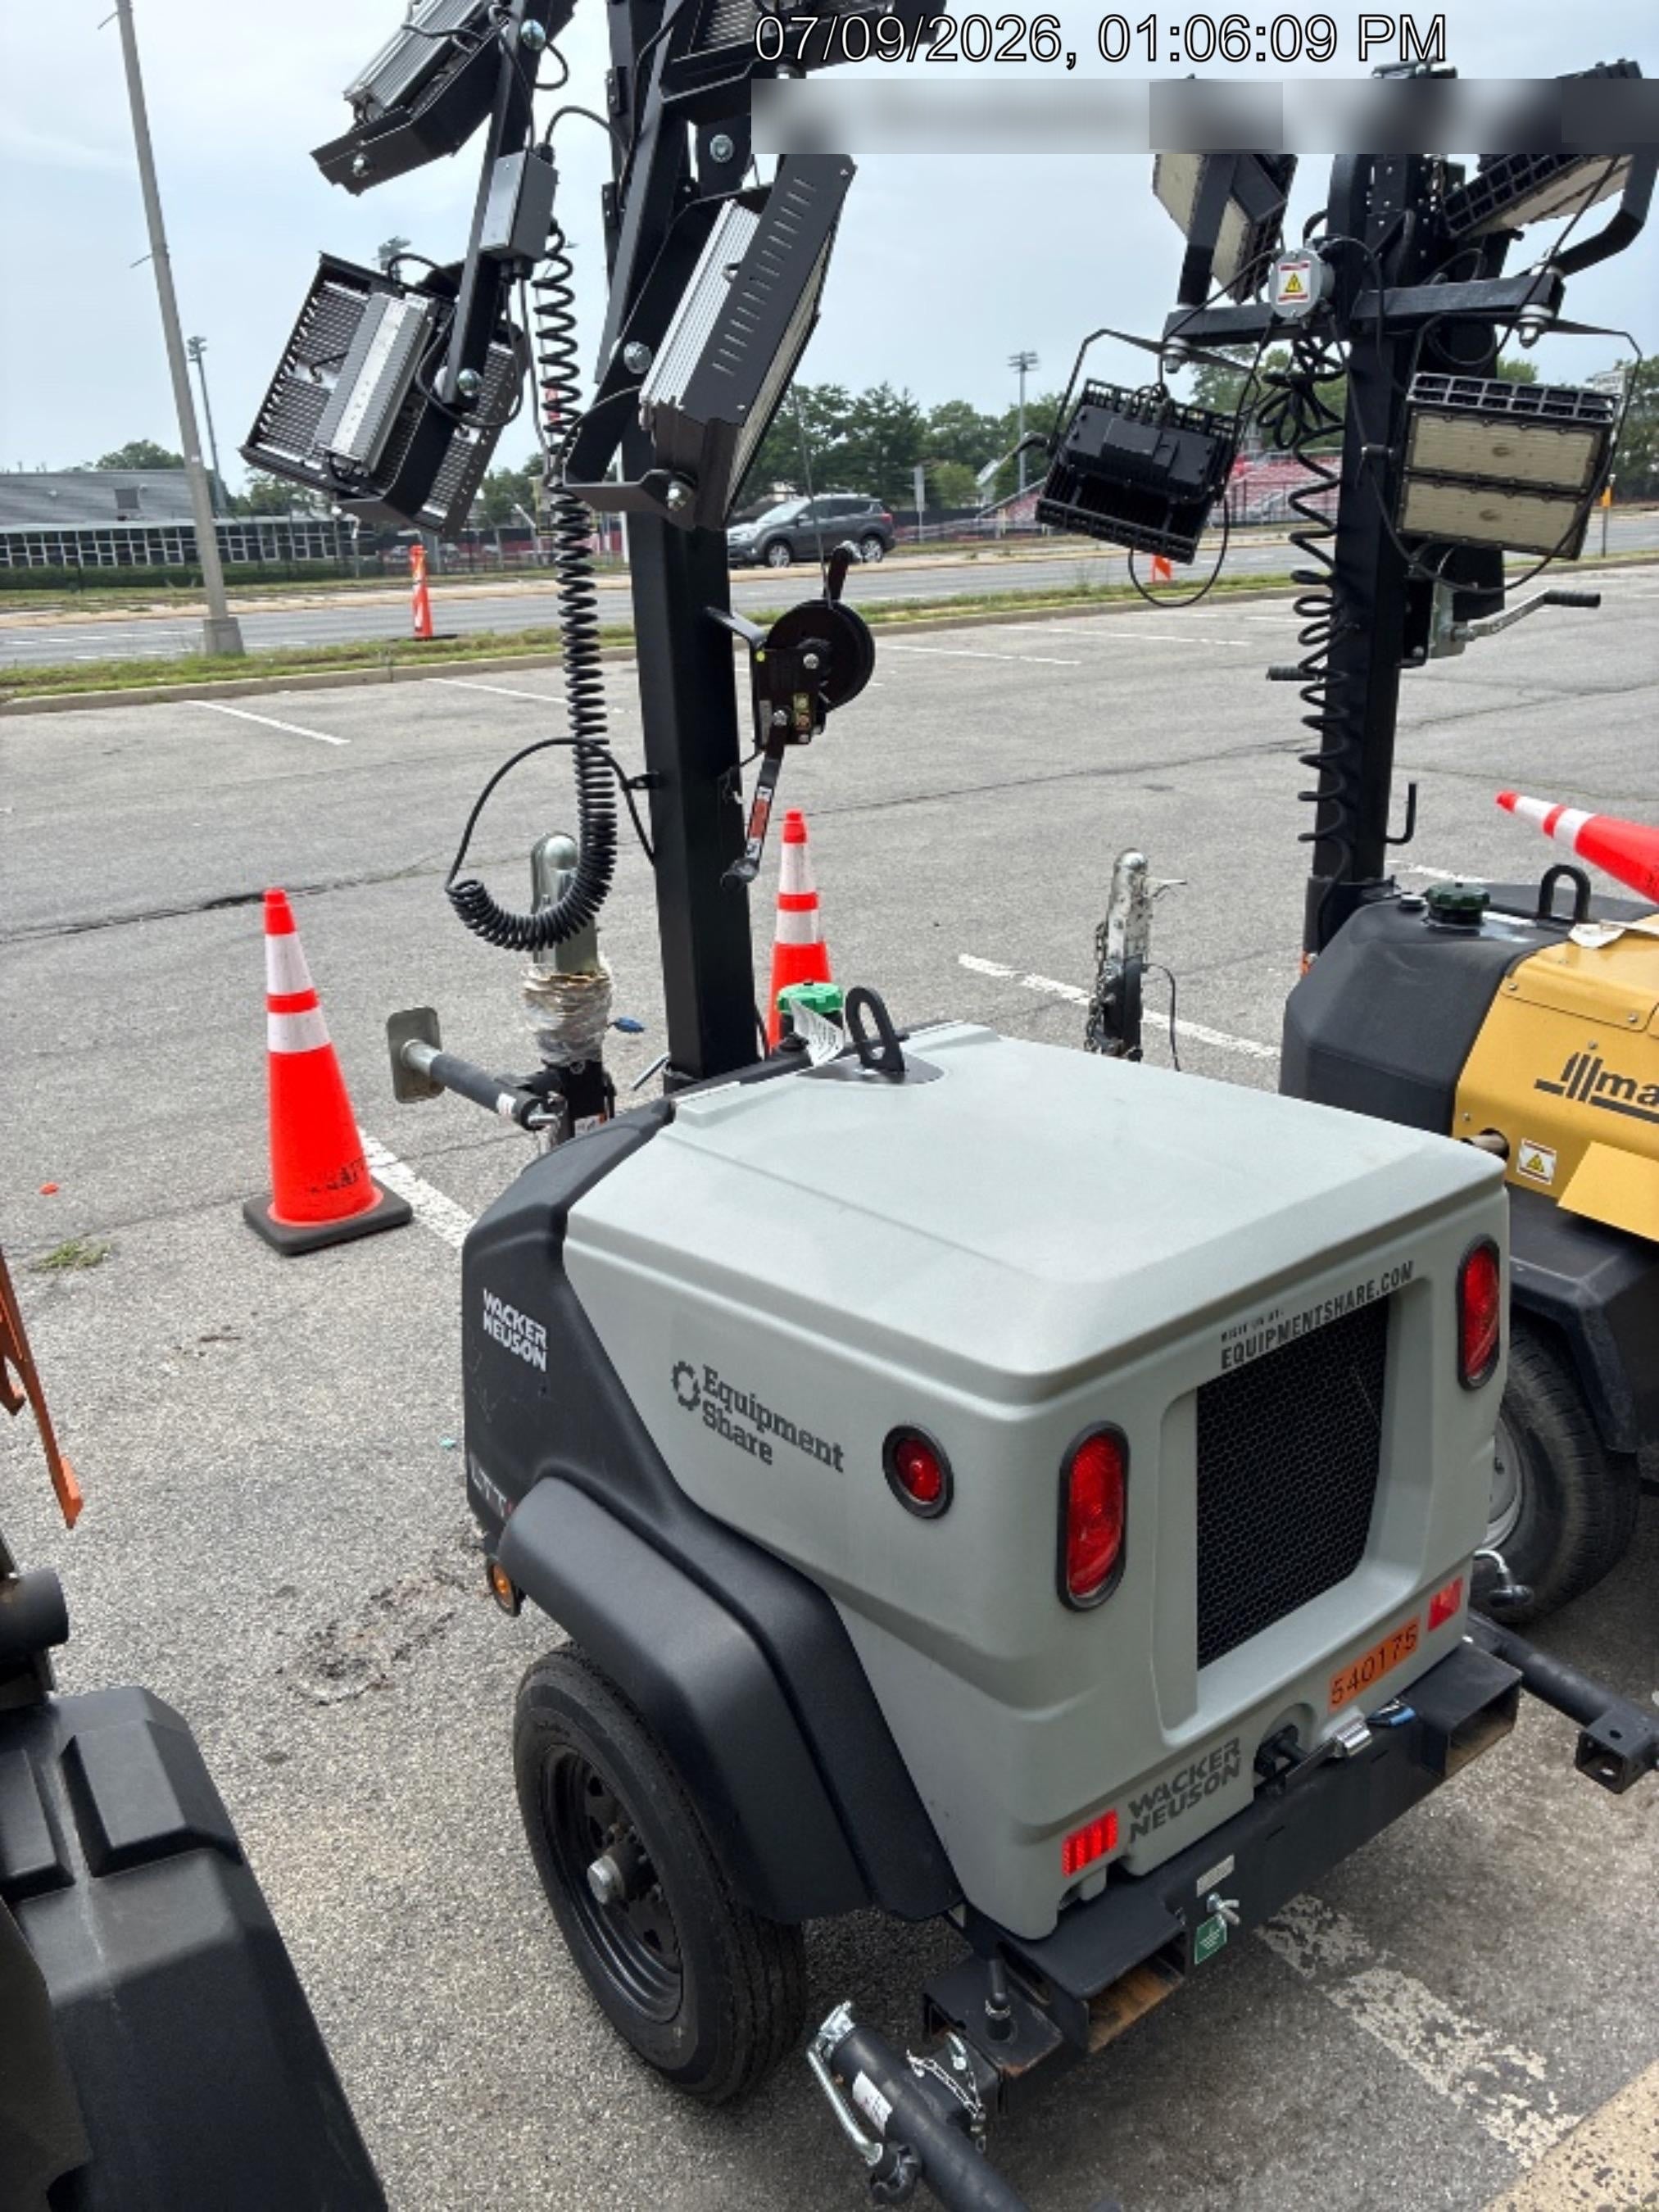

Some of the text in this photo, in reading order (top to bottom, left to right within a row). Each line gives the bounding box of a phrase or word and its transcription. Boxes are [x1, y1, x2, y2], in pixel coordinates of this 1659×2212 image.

[483, 1287, 547, 1349] WACKER
[483, 1310, 546, 1372] NEUSON
[702, 1363, 844, 1473] Equipment
[702, 1399, 773, 1465] Share
[1331, 1624, 1417, 1704] 540175
[1128, 1737, 1241, 1819] WACKER
[1129, 1756, 1241, 1843] NEUSON
